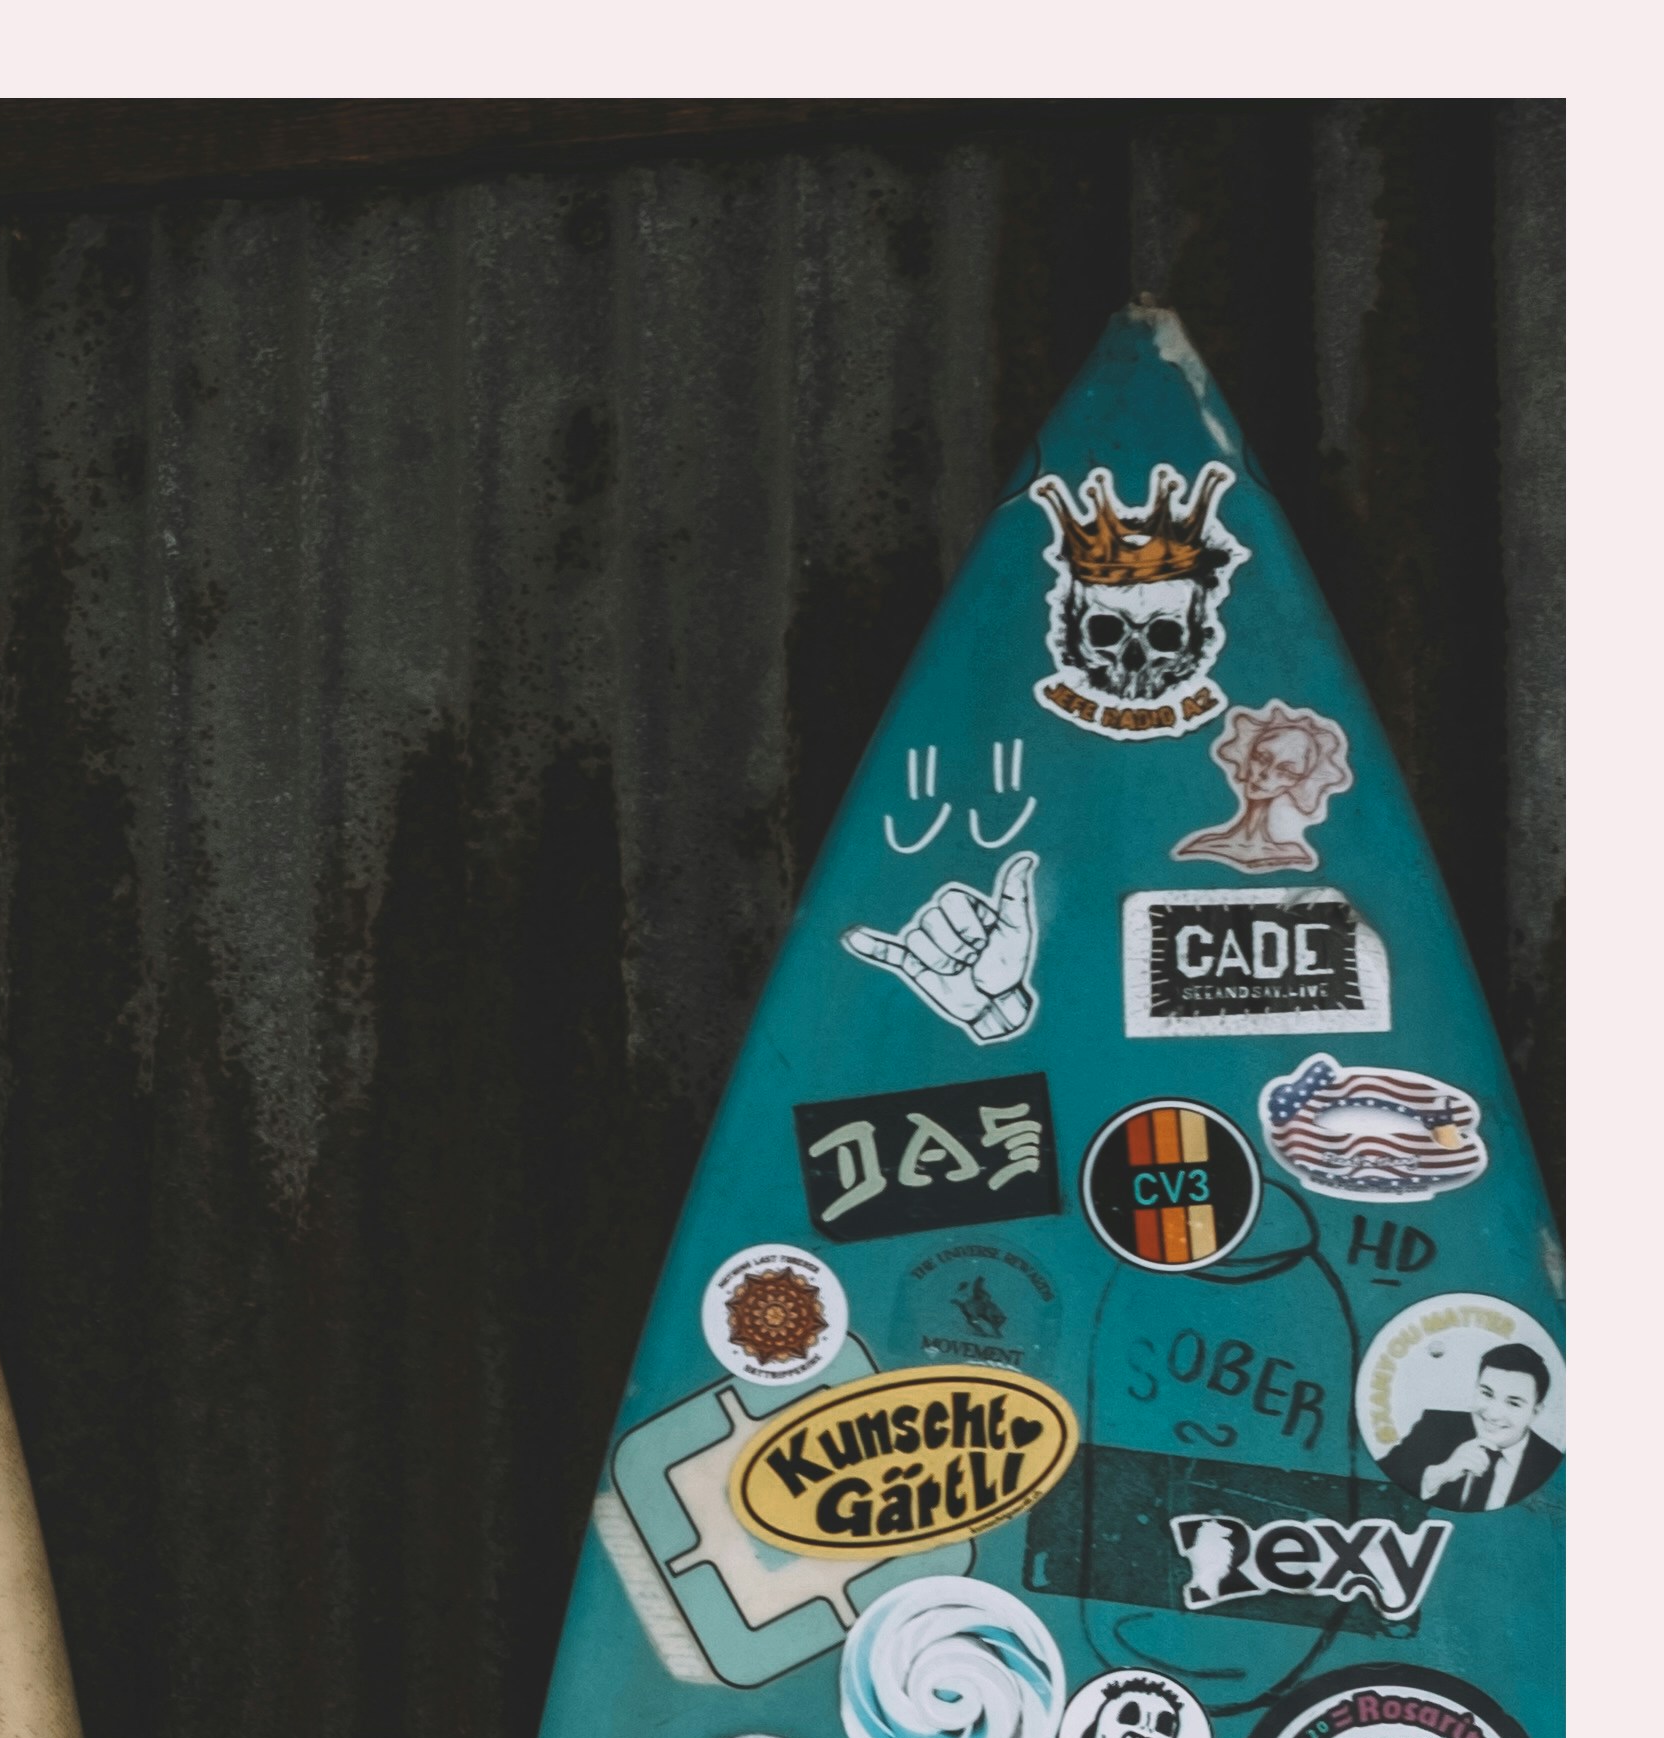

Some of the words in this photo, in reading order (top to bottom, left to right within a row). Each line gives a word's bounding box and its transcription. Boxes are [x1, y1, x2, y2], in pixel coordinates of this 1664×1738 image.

[1133, 1168, 1211, 1206] CV3
[1126, 1327, 1326, 1450] SOBER
[767, 1391, 1010, 1499] Kunscht
